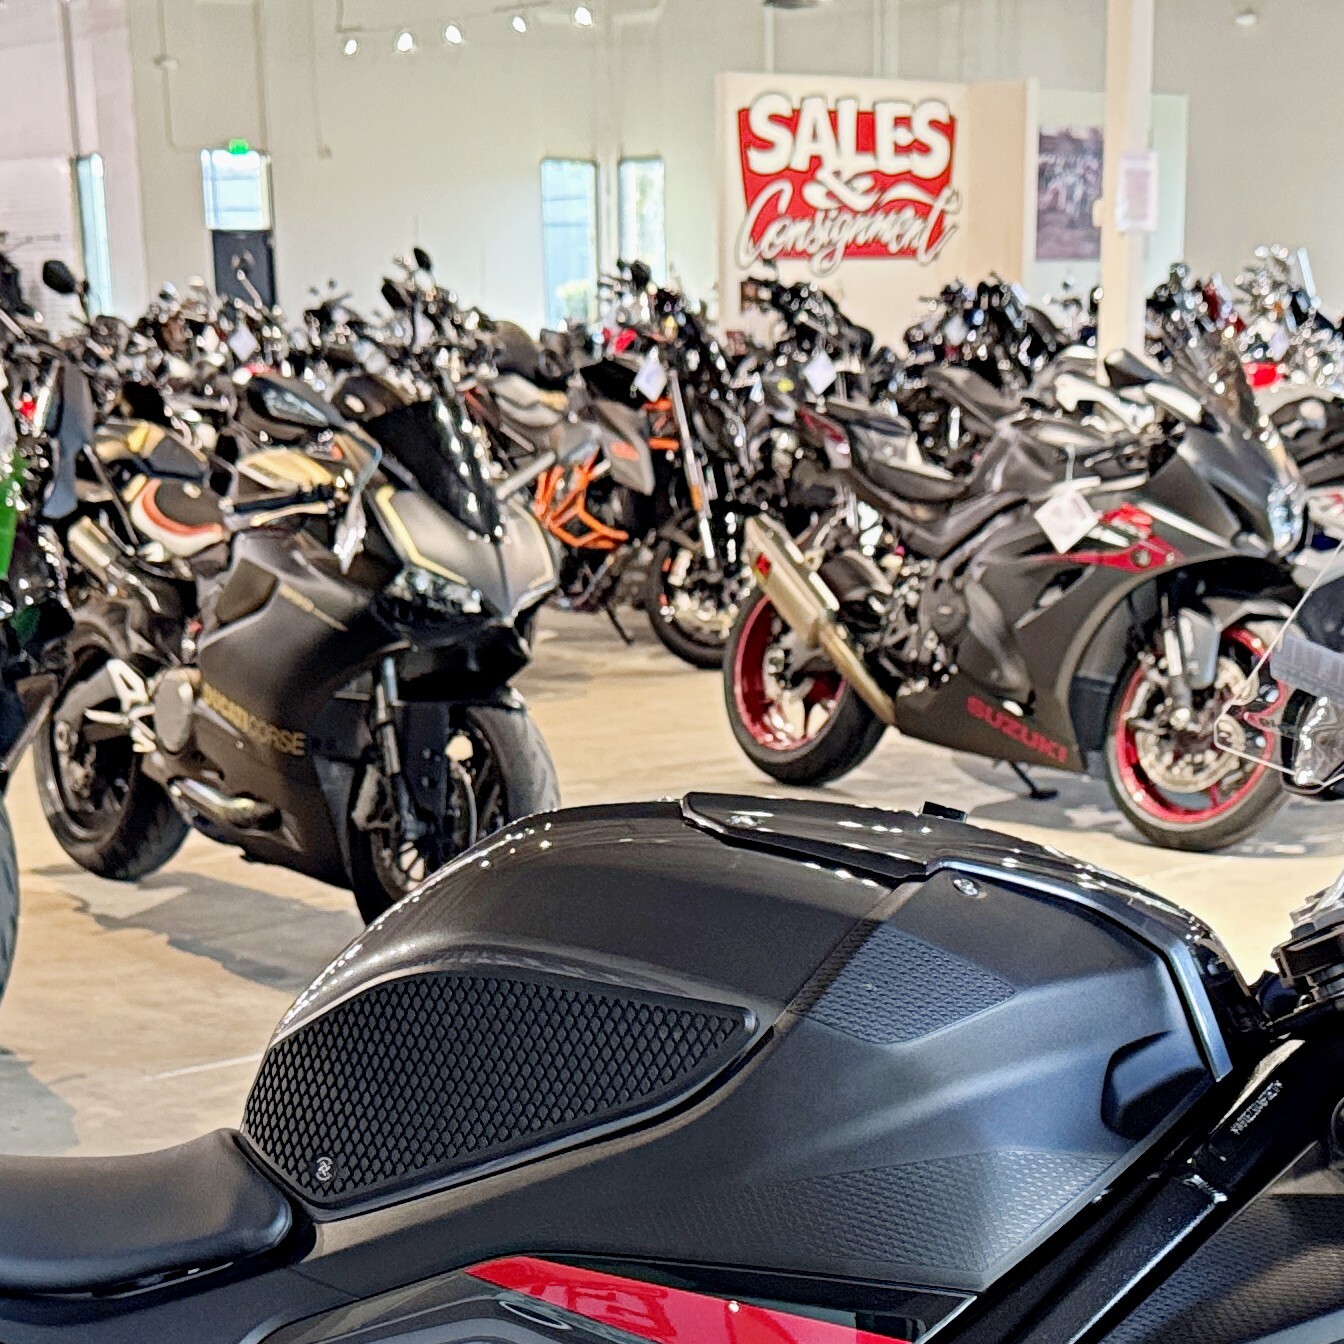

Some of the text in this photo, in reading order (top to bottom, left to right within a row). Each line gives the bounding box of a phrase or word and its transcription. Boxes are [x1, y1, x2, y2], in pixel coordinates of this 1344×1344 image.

[747, 92, 952, 178] SALES
[733, 178, 961, 277] Consignment
[802, 167, 882, 211] &
